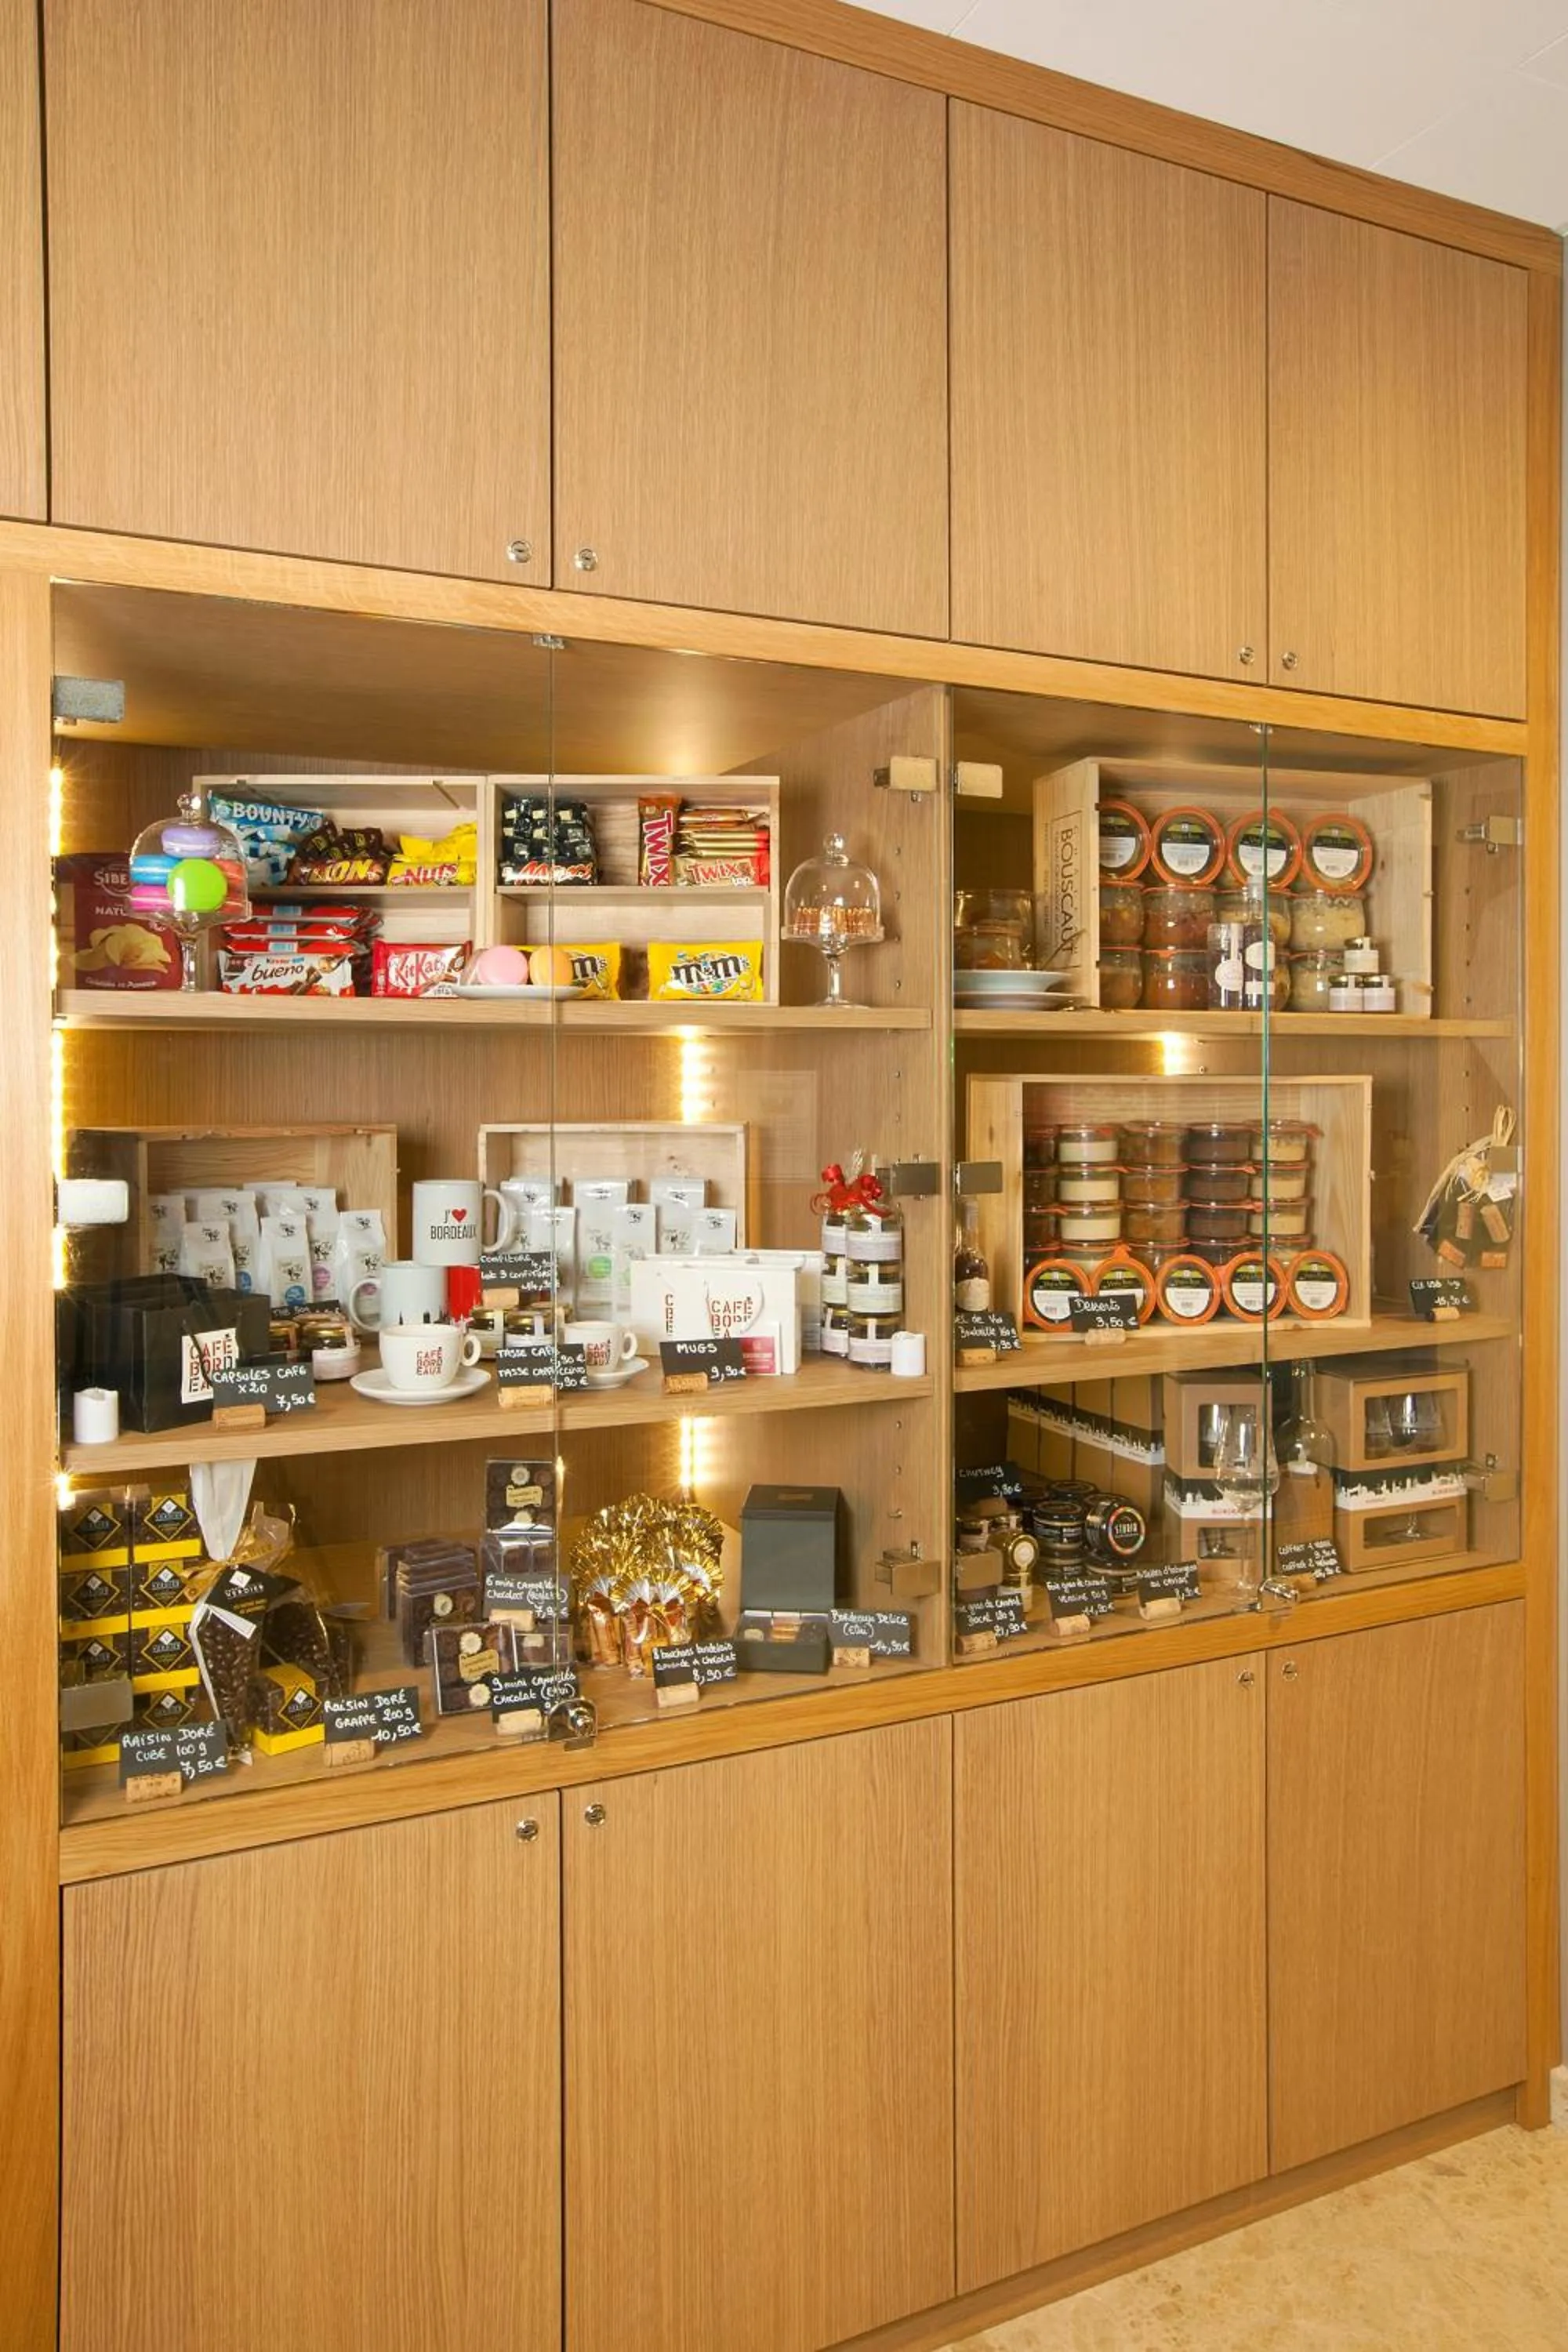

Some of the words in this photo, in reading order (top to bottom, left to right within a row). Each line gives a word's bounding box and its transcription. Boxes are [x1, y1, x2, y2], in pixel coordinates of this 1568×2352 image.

[232, 800, 306, 828] BOUNTY
[93, 868, 129, 886] SIBE
[1060, 827, 1074, 955] BOUSCAUT
[252, 964, 304, 982] bueno
[571, 955, 608, 980] m's
[711, 1296, 753, 1315] CAFÉ
[677, 1343, 717, 1354] MUGS
[189, 1377, 209, 1393] EA
[178, 1721, 215, 1741] DORÉ
